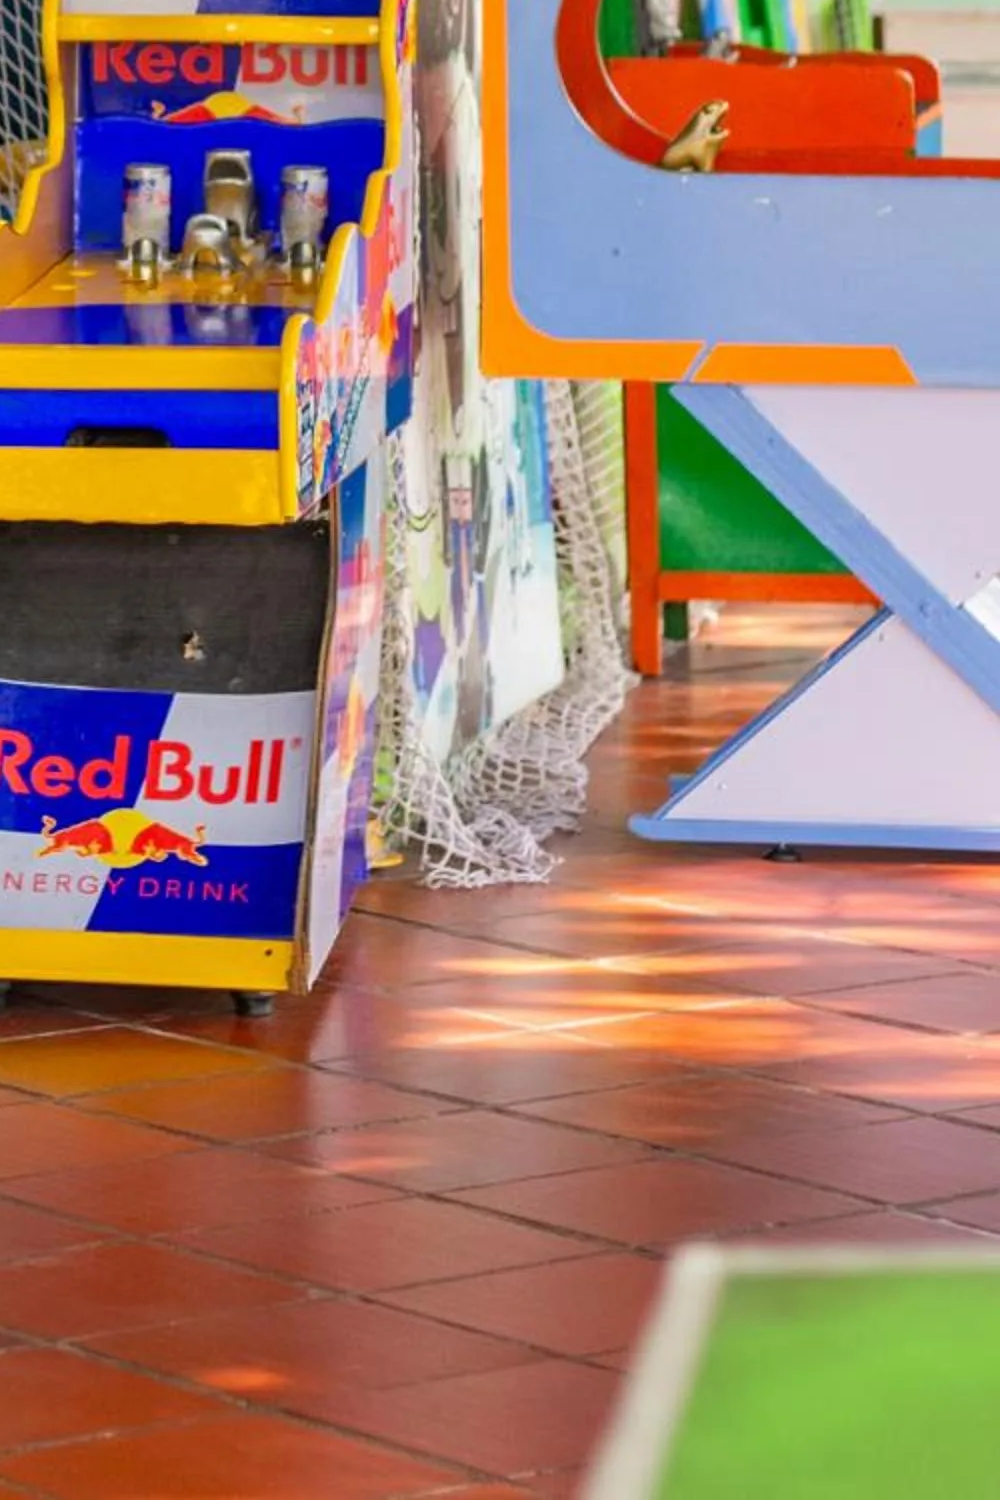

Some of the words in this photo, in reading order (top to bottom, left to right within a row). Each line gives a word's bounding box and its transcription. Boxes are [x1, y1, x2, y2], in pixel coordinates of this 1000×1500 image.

[91, 41, 223, 84] Red
[241, 42, 368, 87] Bull
[143, 739, 285, 805] Bull
[138, 877, 250, 903] DRINK
